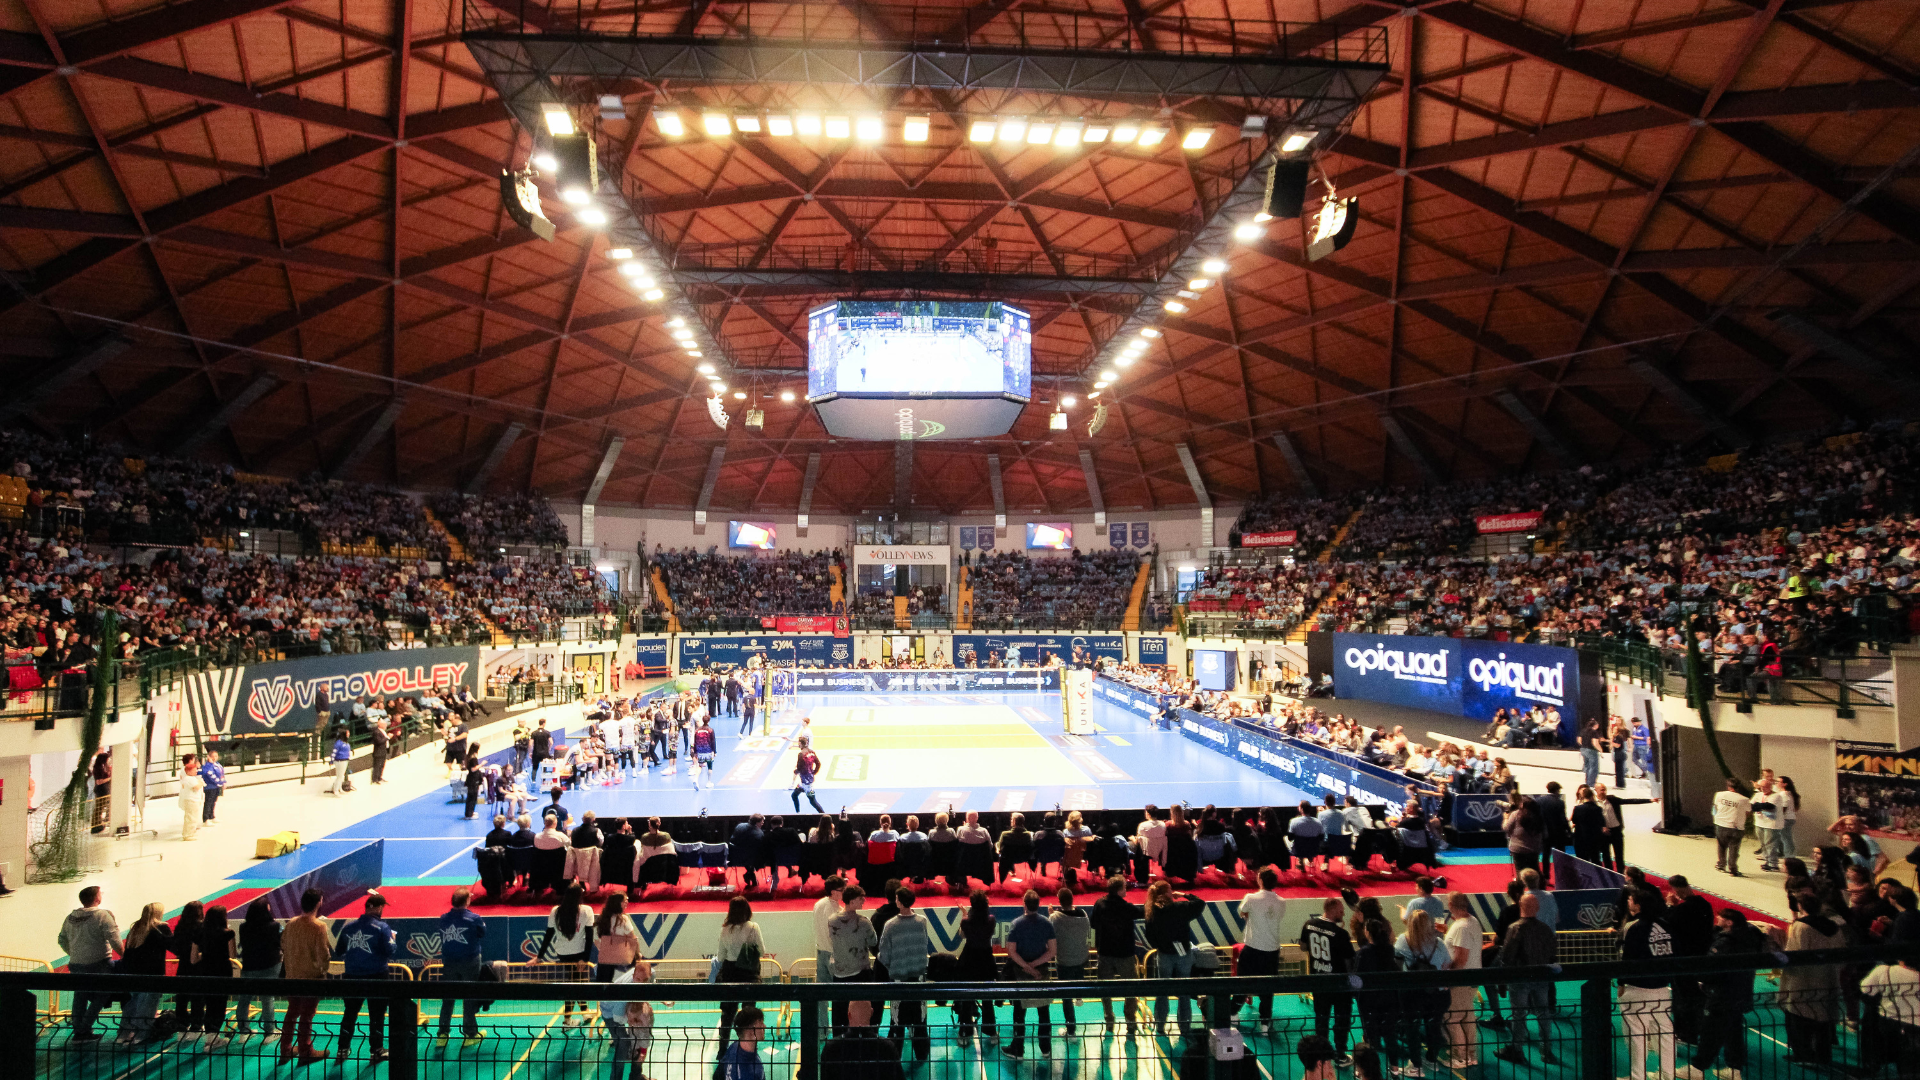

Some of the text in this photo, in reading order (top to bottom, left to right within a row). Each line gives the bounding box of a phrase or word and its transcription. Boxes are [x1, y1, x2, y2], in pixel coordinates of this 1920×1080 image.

[1244, 535, 1294, 544] delicatesse
[638, 644, 666, 653] mauden
[771, 640, 796, 651] SYM
[1142, 642, 1164, 652] iren
[1345, 643, 1449, 679] opiquad
[827, 678, 866, 686] BUSINESS
[1469, 652, 1564, 698] opiquad
[1077, 681, 1087, 726] UNIKA
[1260, 749, 1296, 774] BUSINESS
[1837, 754, 1920, 775] WINN
[1316, 772, 1347, 796] ASUS
[1721, 799, 1740, 809] CREW
[1310, 932, 1332, 961] 69
